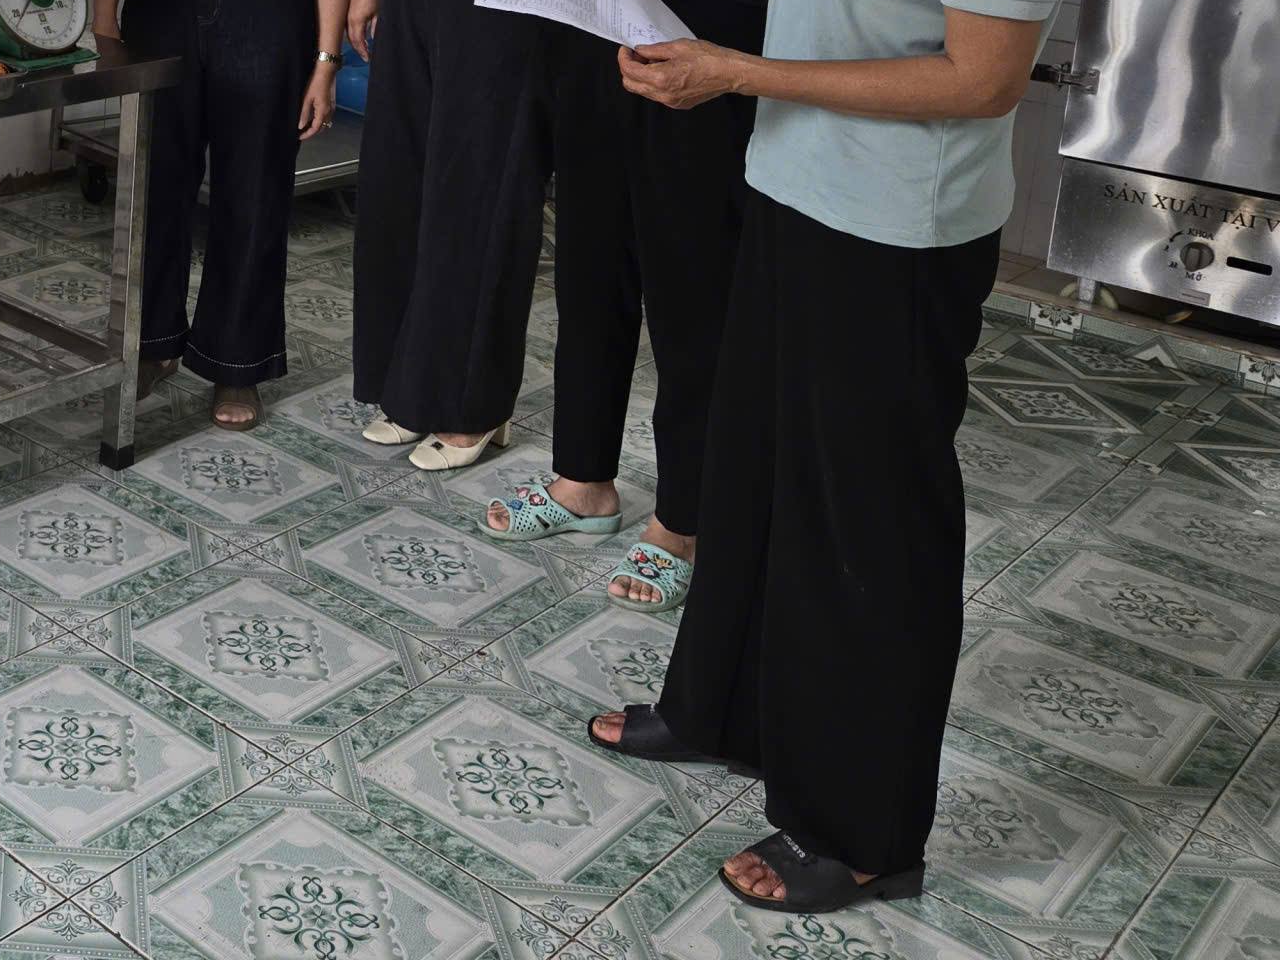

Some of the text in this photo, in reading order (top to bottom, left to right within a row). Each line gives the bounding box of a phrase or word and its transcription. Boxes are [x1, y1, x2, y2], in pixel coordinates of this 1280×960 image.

[1104, 183, 1147, 205] SẢN
[1152, 194, 1214, 218] XUẤT
[1220, 208, 1259, 230] TẠI
